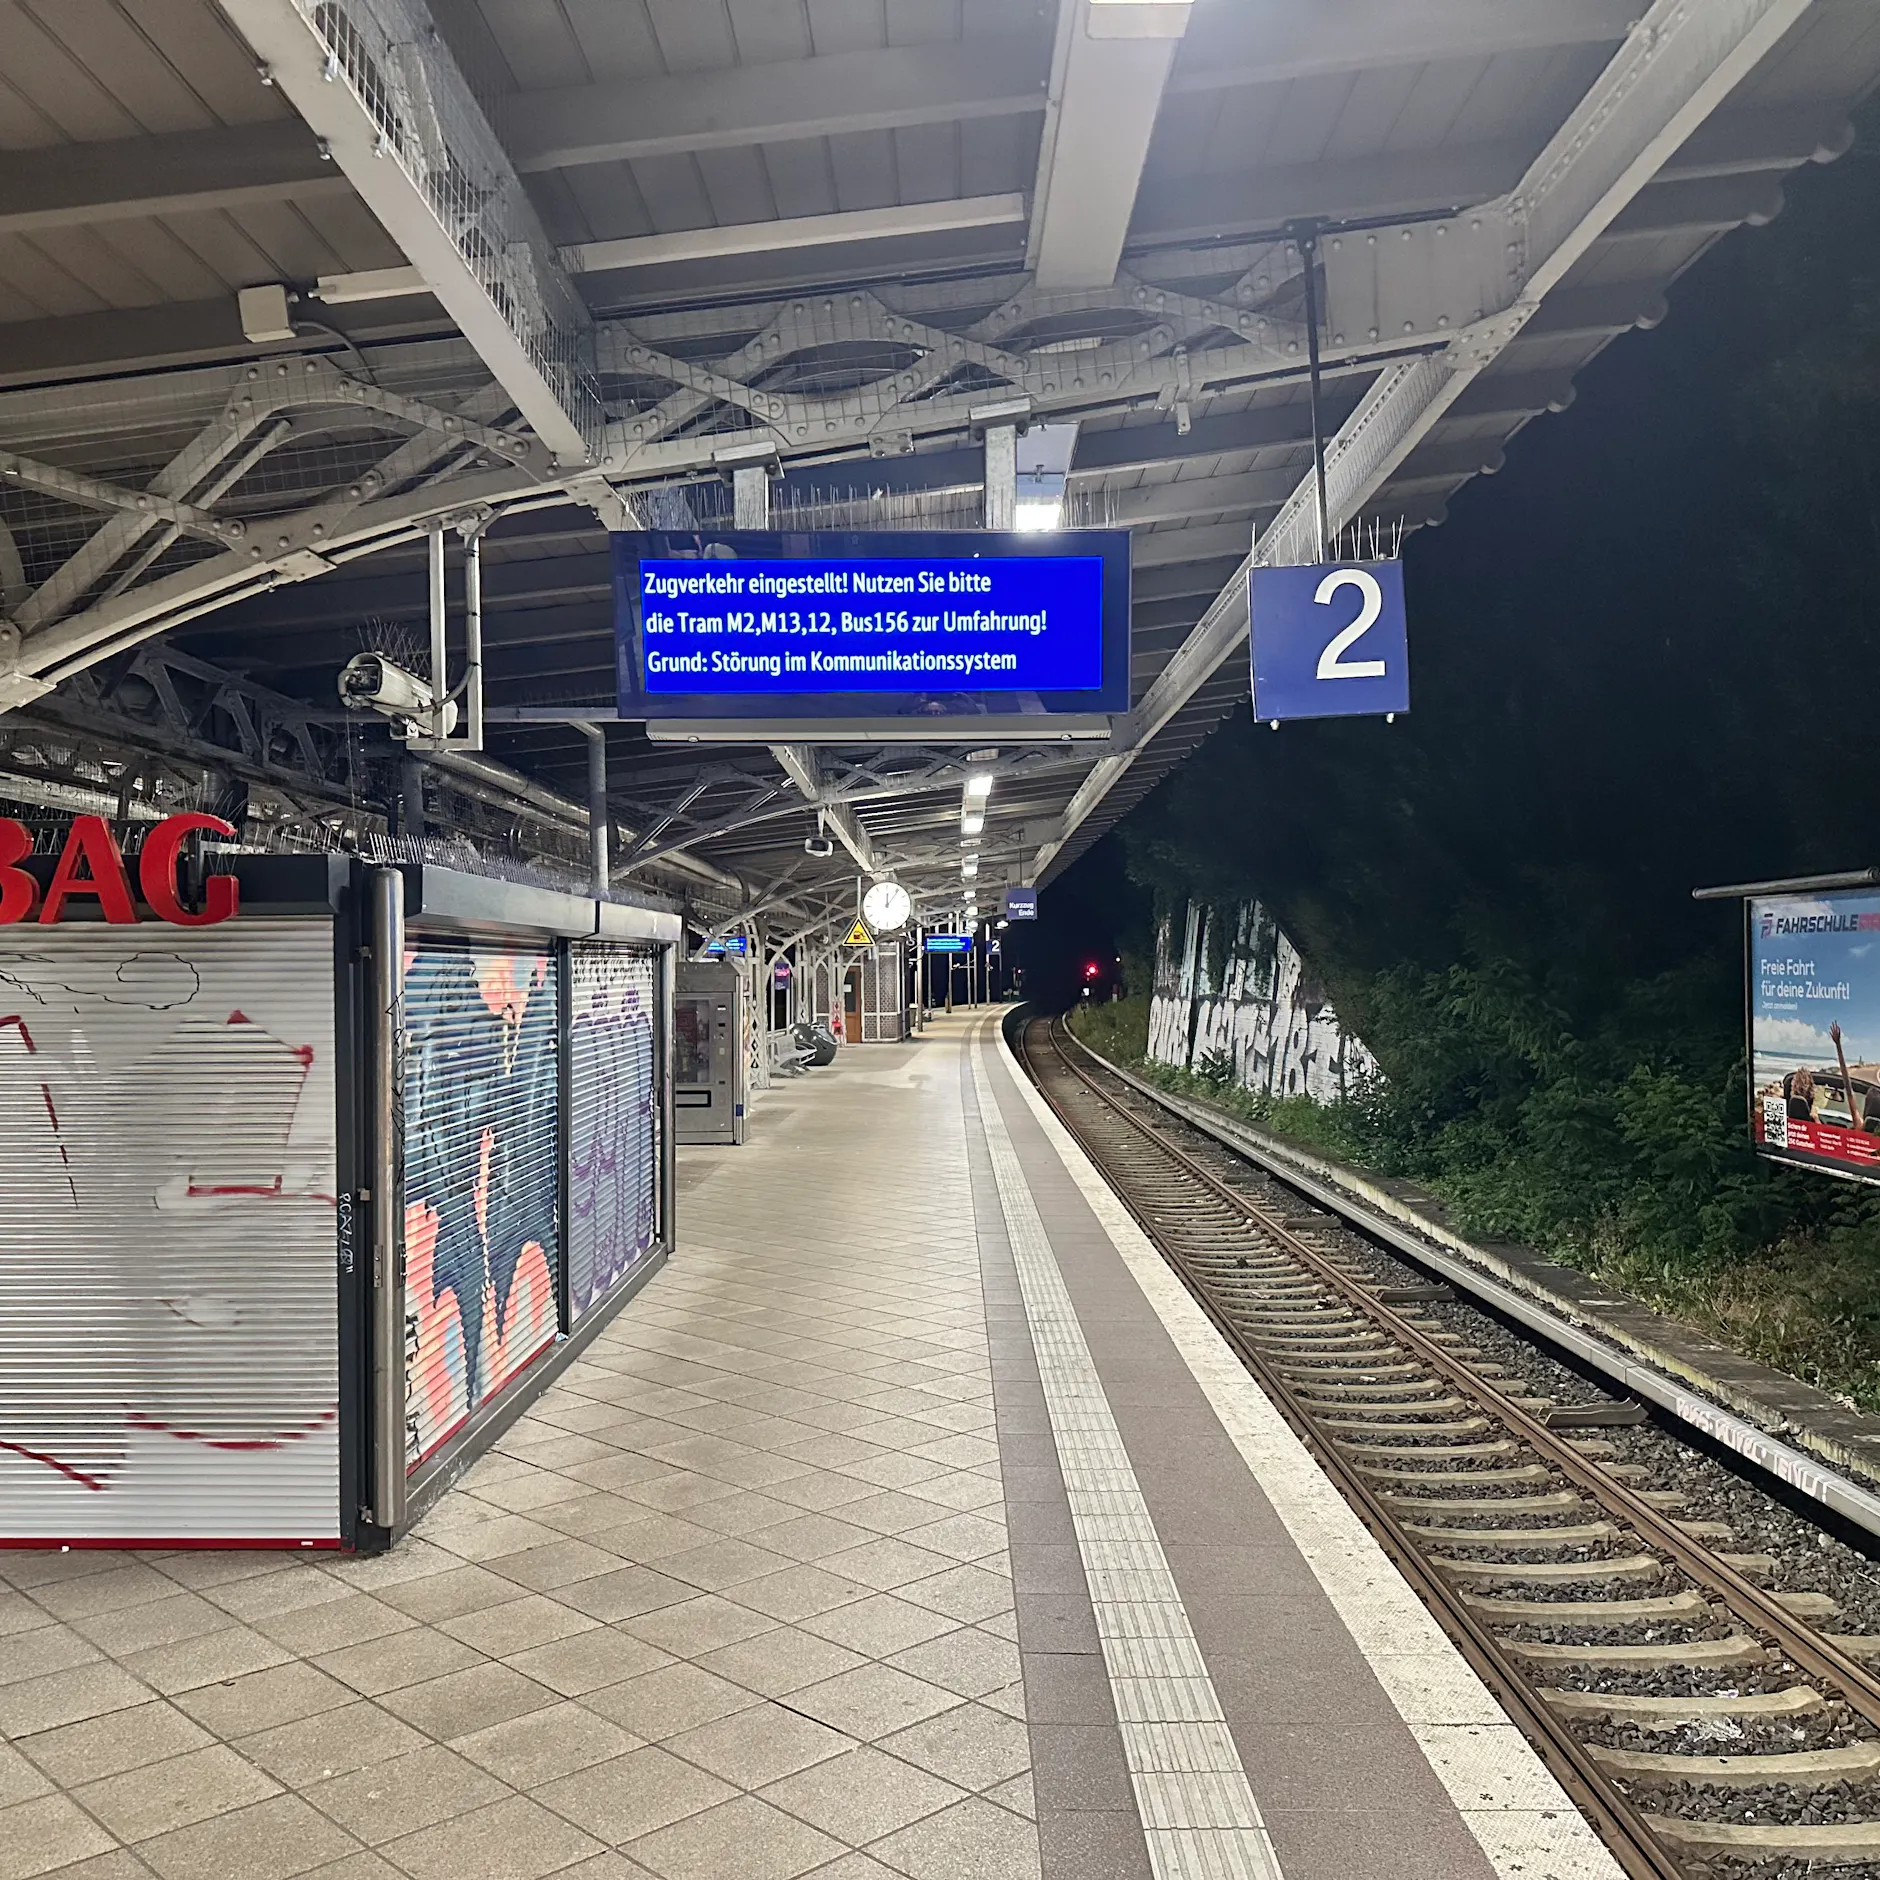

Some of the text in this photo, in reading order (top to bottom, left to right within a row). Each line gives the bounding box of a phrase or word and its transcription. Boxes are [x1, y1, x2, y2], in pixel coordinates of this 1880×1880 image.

[644, 571, 992, 599] Zugverkehr eingestellt! Nutzen Sie bitte
[646, 612, 674, 633] die
[677, 612, 723, 633] Tram
[841, 610, 909, 633] Bus156
[912, 615, 939, 632] zur
[944, 610, 1047, 636] Umfahrung!
[1314, 568, 1386, 680] 2
[648, 650, 1016, 677] Grund: Störung im Kommunikationssystem
[1018, 909, 1035, 917] Ende
[1776, 914, 1859, 934] FAHRSCHULE
[991, 939, 1000, 952] 2
[1761, 958, 1815, 976] Freie Fahrt
[1761, 980, 1850, 1000] für deine Zukunft!
